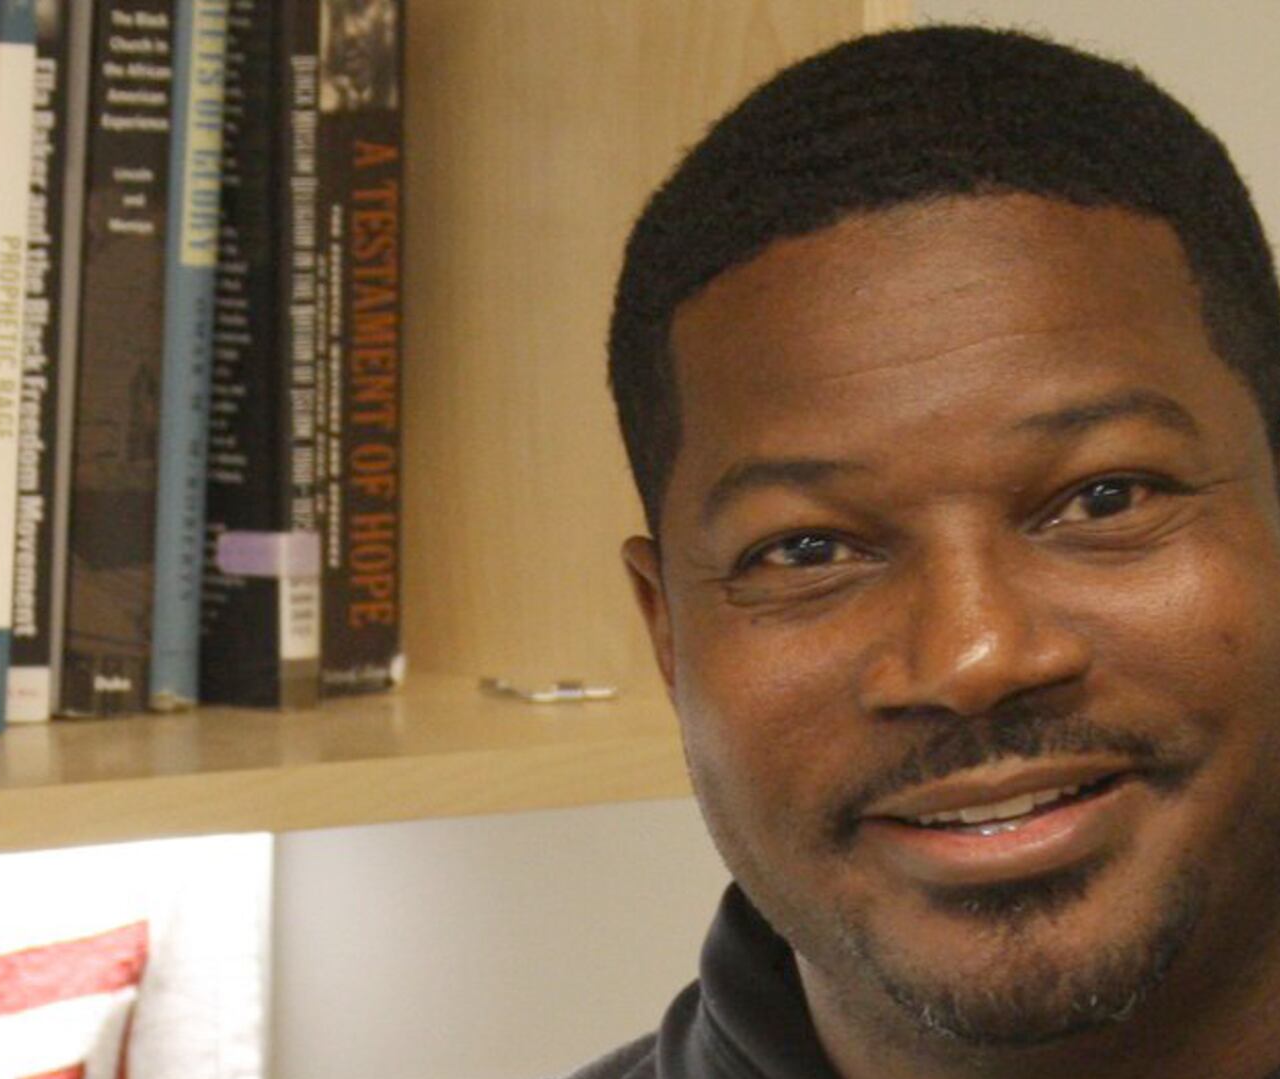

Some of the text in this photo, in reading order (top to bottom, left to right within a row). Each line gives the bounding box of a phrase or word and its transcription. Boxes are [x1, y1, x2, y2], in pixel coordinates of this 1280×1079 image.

[134, 11, 168, 28] Black
[109, 36, 151, 53] Church
[127, 63, 172, 79] African
[107, 89, 167, 105] American
[101, 114, 169, 132] Experience
[353, 141, 398, 168] A
[350, 183, 398, 430] TESTAMENT
[18, 376, 49, 491] Freedom
[349, 444, 397, 499] OF
[13, 495, 44, 637] Movement
[348, 513, 397, 629] HOPE
[94, 674, 132, 692] Duke
